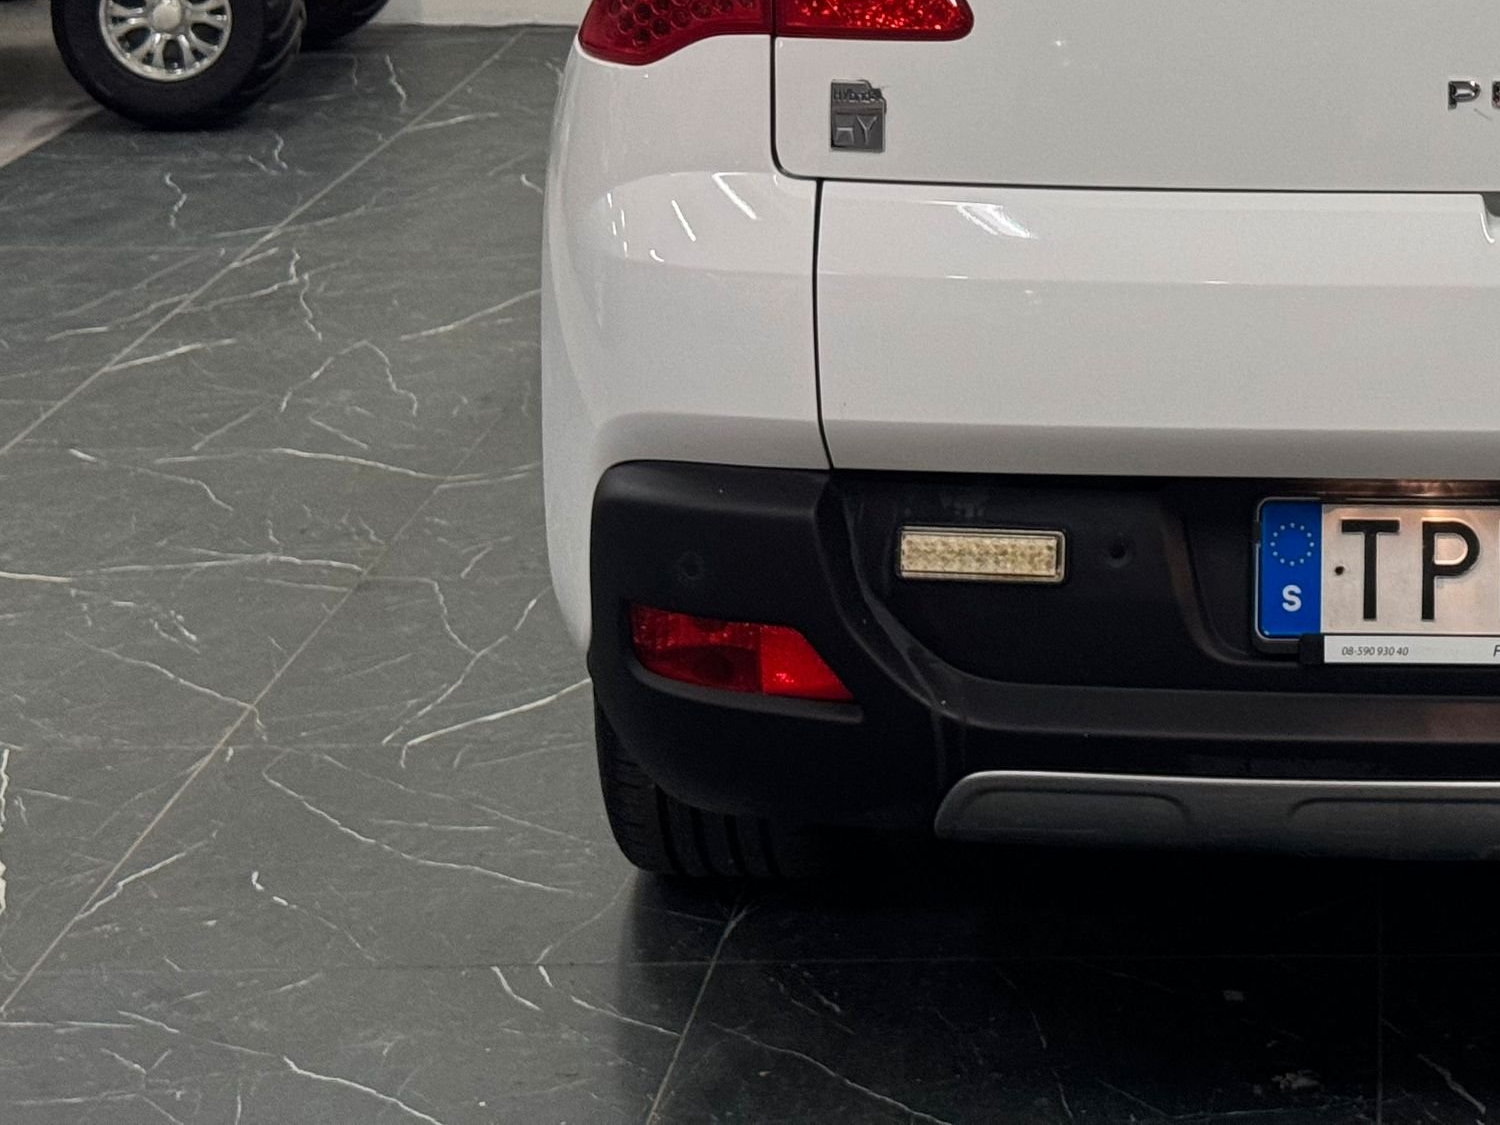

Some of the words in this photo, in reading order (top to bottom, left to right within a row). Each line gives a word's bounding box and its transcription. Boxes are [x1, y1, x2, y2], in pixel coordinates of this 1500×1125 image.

[1281, 584, 1302, 612] S
[1341, 646, 1376, 656] 08-590
[1376, 647, 1395, 656] 930
[1396, 647, 1409, 656] 40
